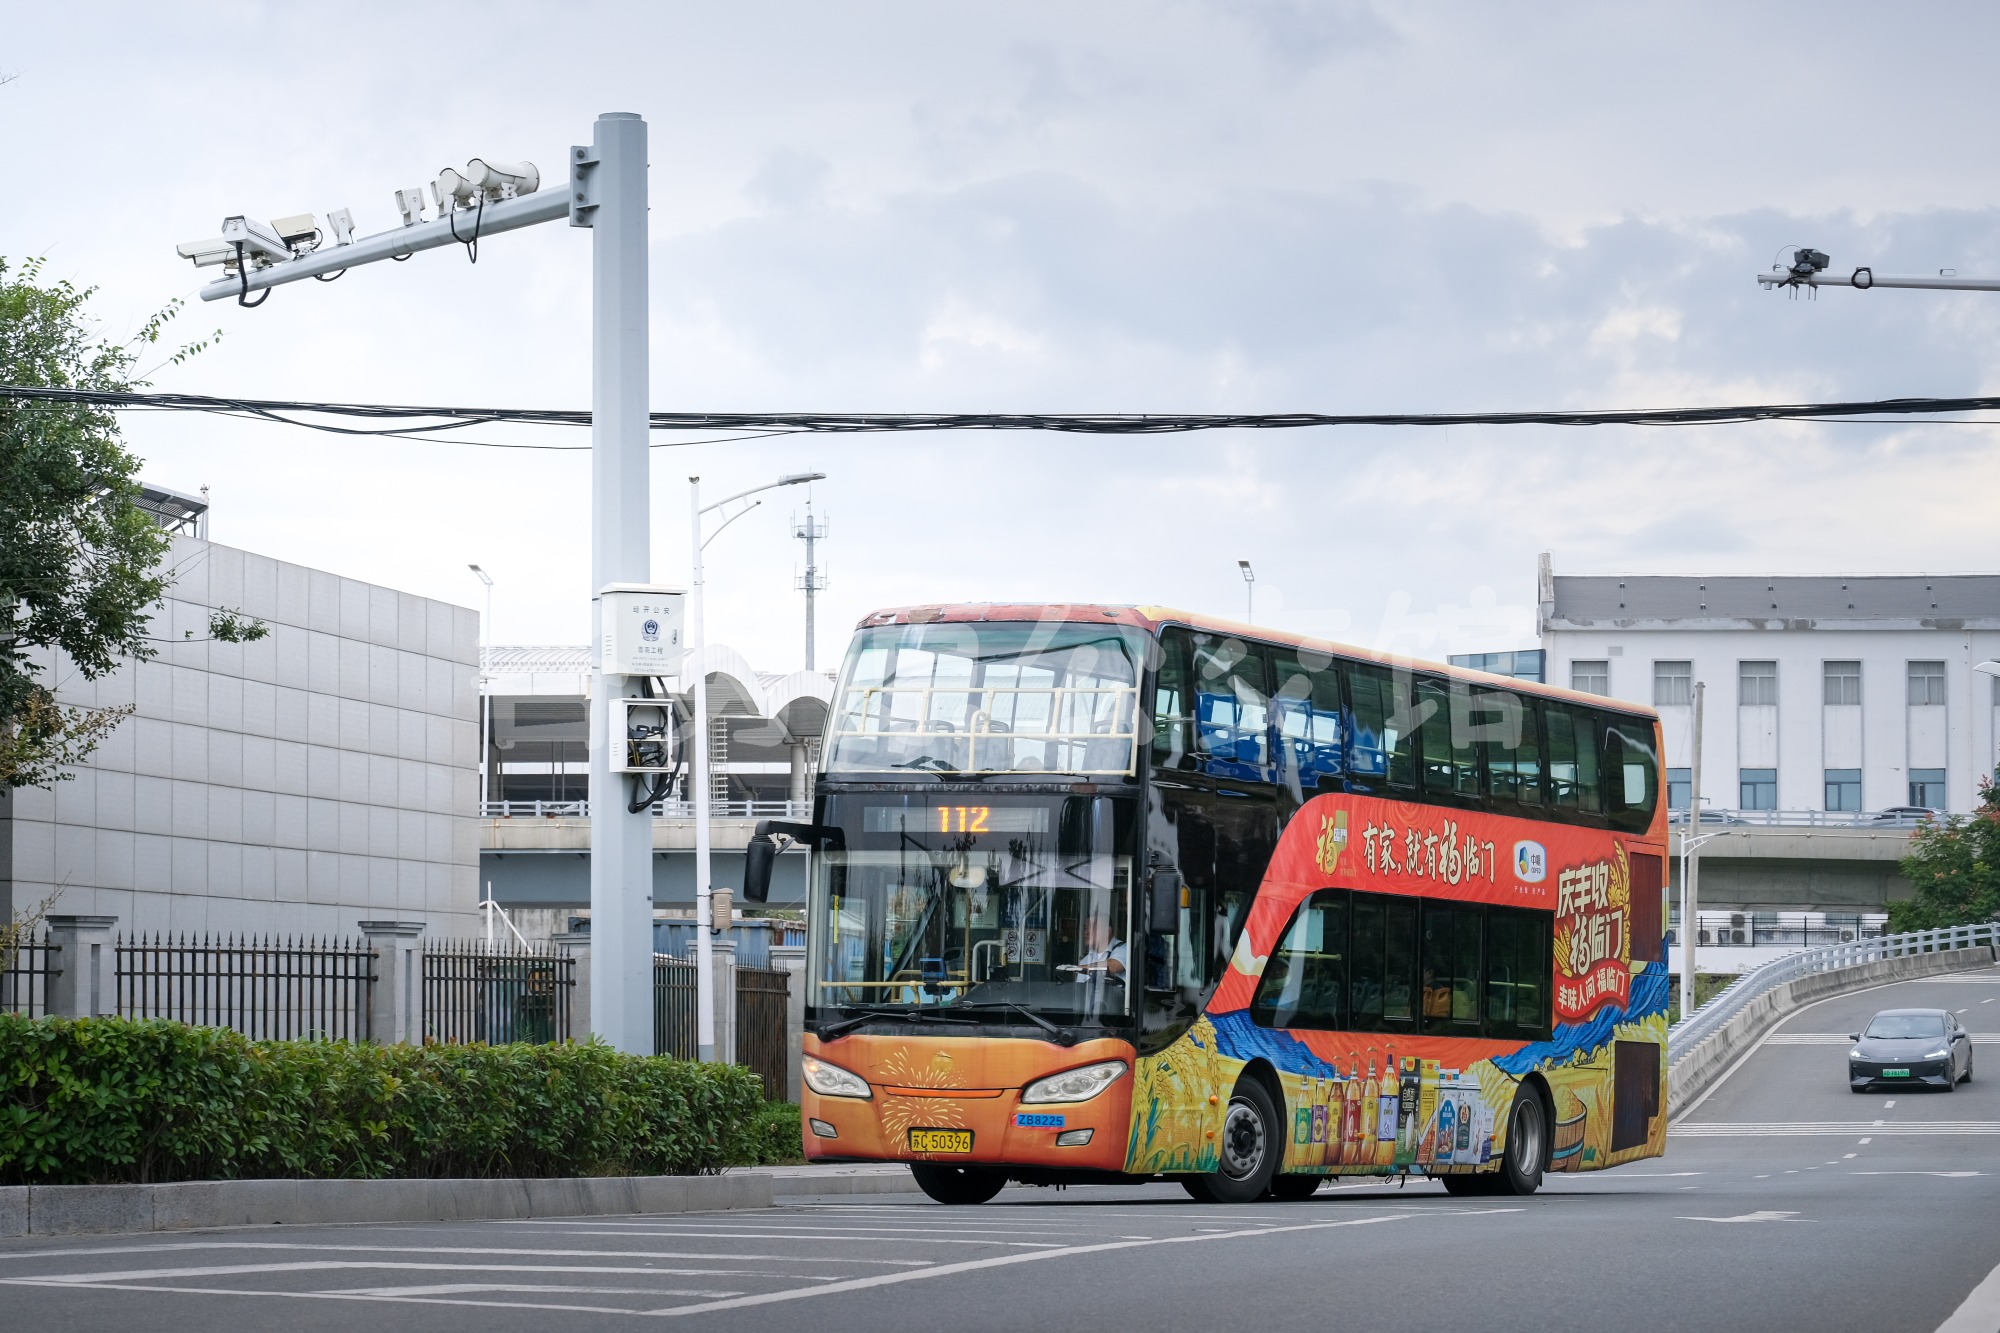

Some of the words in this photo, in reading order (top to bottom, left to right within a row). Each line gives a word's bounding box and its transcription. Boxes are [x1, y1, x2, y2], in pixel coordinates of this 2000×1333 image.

[938, 806, 990, 833] 112
[1558, 862, 1609, 918] 庆丰收
[1570, 910, 1622, 974] 福临门
[1558, 976, 1596, 1012] 丰味人间
[1596, 966, 1625, 997] 福临门
[1018, 1115, 1063, 1126] ZB8225
